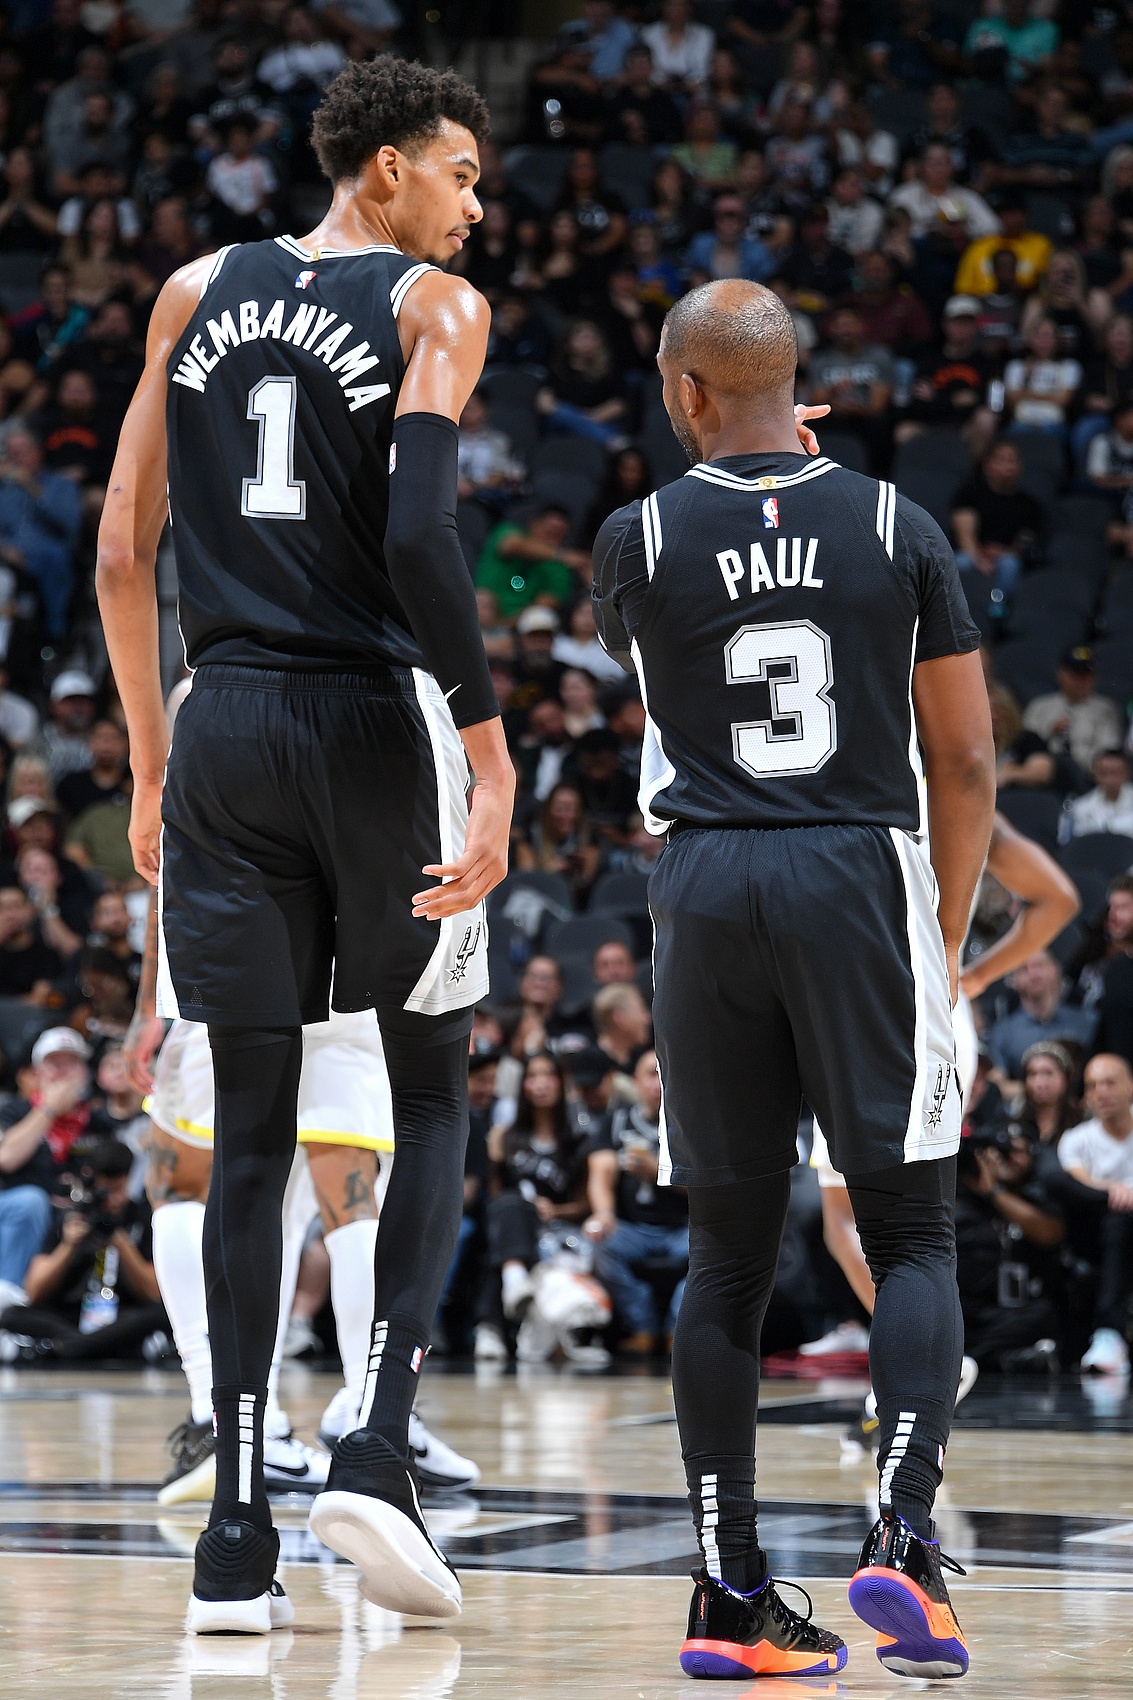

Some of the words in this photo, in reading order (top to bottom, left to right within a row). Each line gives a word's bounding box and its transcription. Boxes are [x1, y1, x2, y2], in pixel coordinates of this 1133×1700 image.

[171, 299, 391, 413] WEMBANYAMA
[241, 375, 306, 521] 1
[715, 537, 824, 601] PAUL
[723, 618, 838, 779] 3
